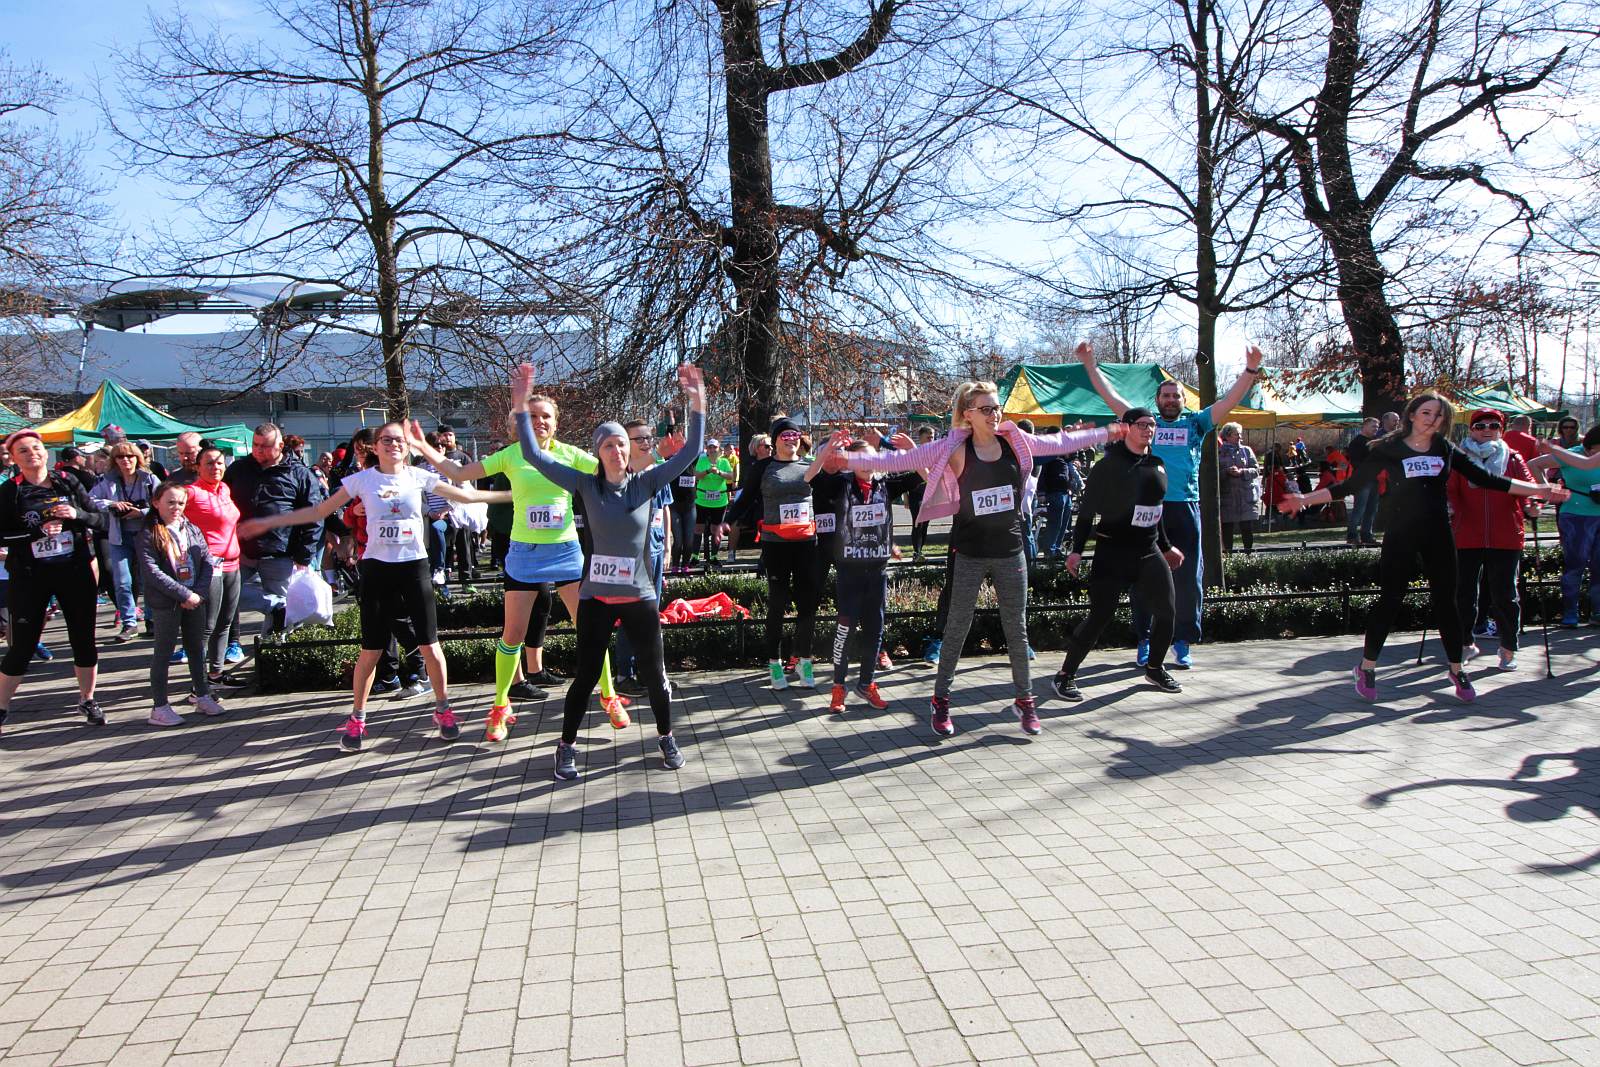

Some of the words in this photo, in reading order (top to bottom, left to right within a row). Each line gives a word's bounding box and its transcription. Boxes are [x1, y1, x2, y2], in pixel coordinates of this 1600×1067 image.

[1158, 432, 1174, 441] 244
[1406, 461, 1430, 472] 265
[977, 494, 998, 509] 267
[530, 511, 550, 523] 078
[783, 508, 799, 519] 212
[855, 510, 874, 522] 225
[1135, 511, 1154, 522] 263
[817, 518, 834, 528] 269
[379, 526, 400, 538] 207
[36, 539, 58, 553] 287
[593, 562, 617, 577] 302
